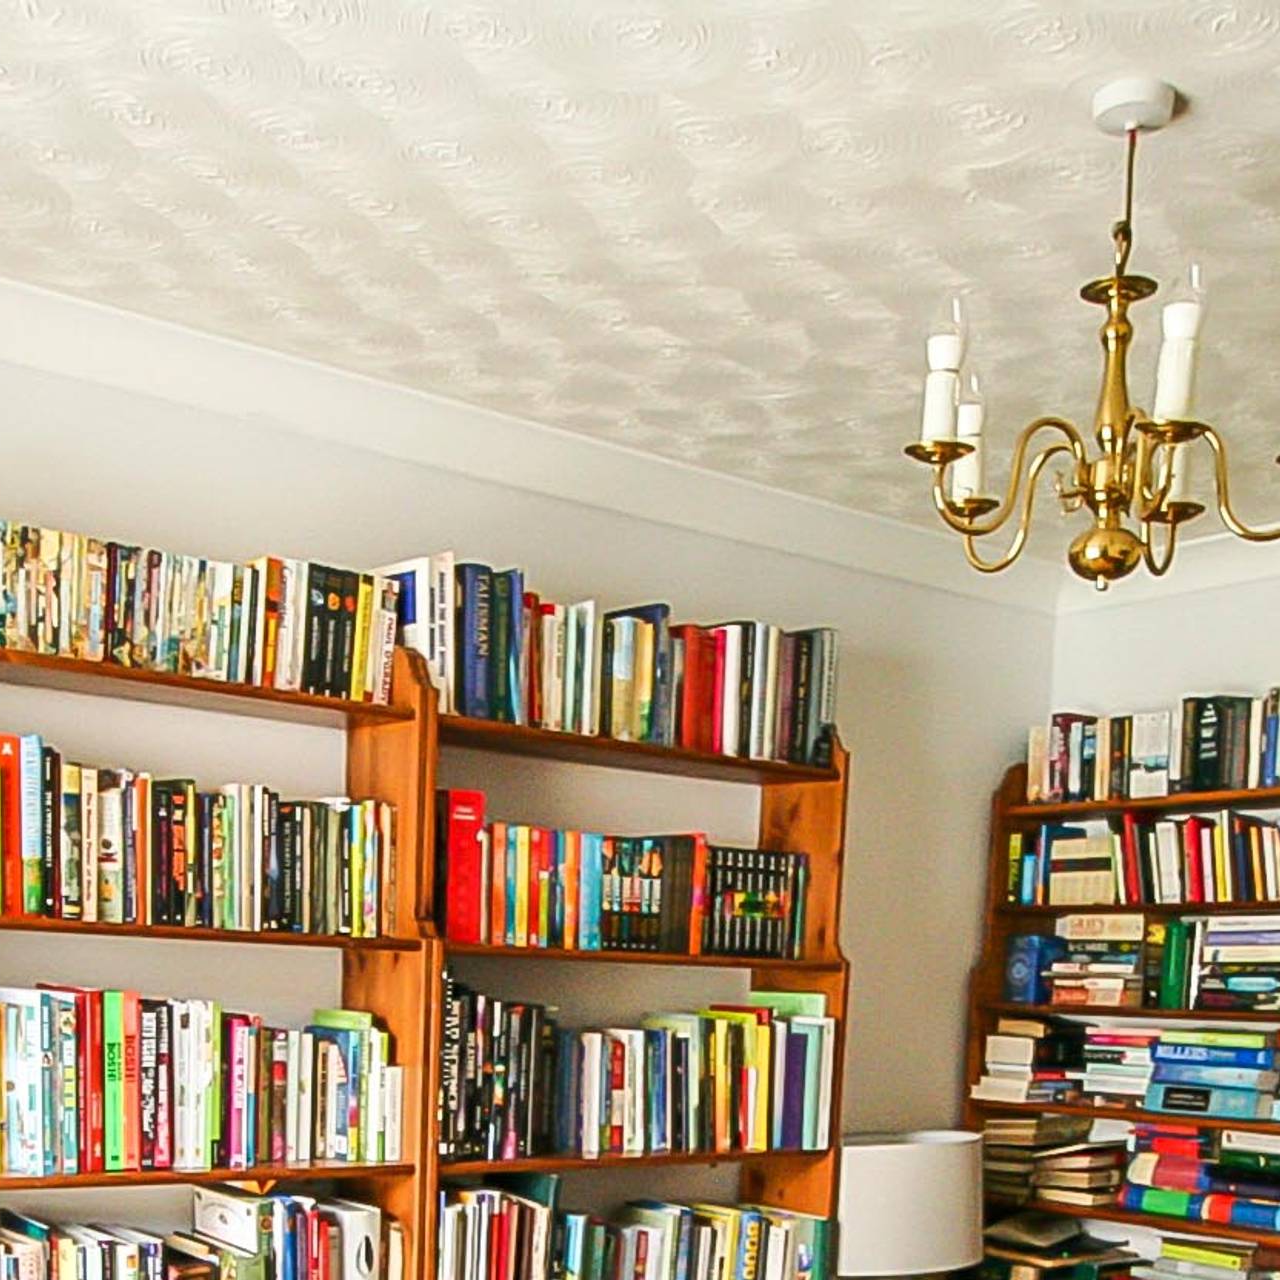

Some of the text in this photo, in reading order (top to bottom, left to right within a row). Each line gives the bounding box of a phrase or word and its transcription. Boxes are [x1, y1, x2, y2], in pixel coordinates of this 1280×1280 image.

[477, 574, 490, 657] TALISMAN
[106, 1042, 116, 1081] BOSH!
[125, 1035, 136, 1083] BOSH!
